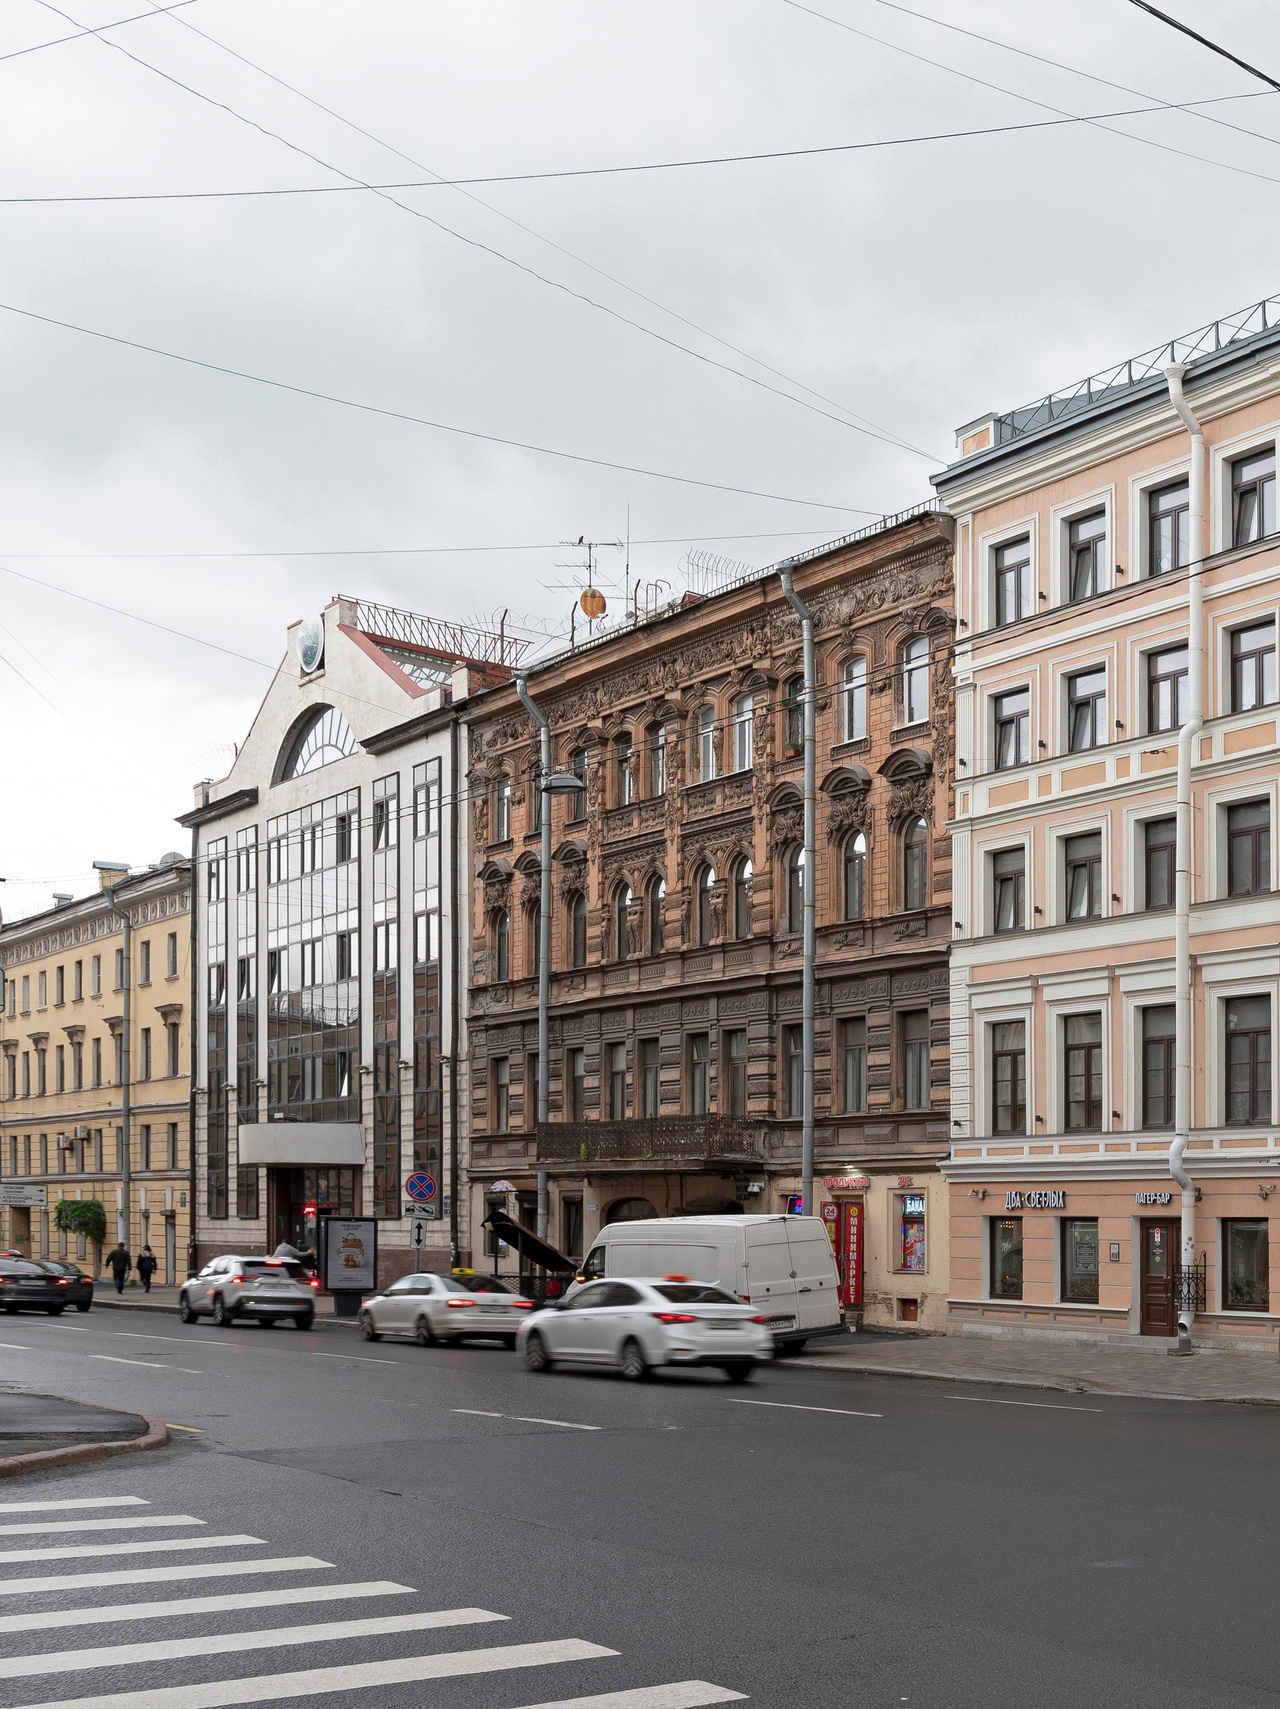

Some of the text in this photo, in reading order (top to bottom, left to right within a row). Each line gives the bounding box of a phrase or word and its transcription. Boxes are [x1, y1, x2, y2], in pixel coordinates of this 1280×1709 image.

[822, 1176, 867, 1188] ПРОДУКТЫ
[898, 1176, 909, 1187] 24
[1005, 1191, 1021, 1210] ДВА
[1135, 1192, 1170, 1204] ЛАГЕР-БАР
[849, 1217, 858, 1303] МИНИМАРКЕТ
